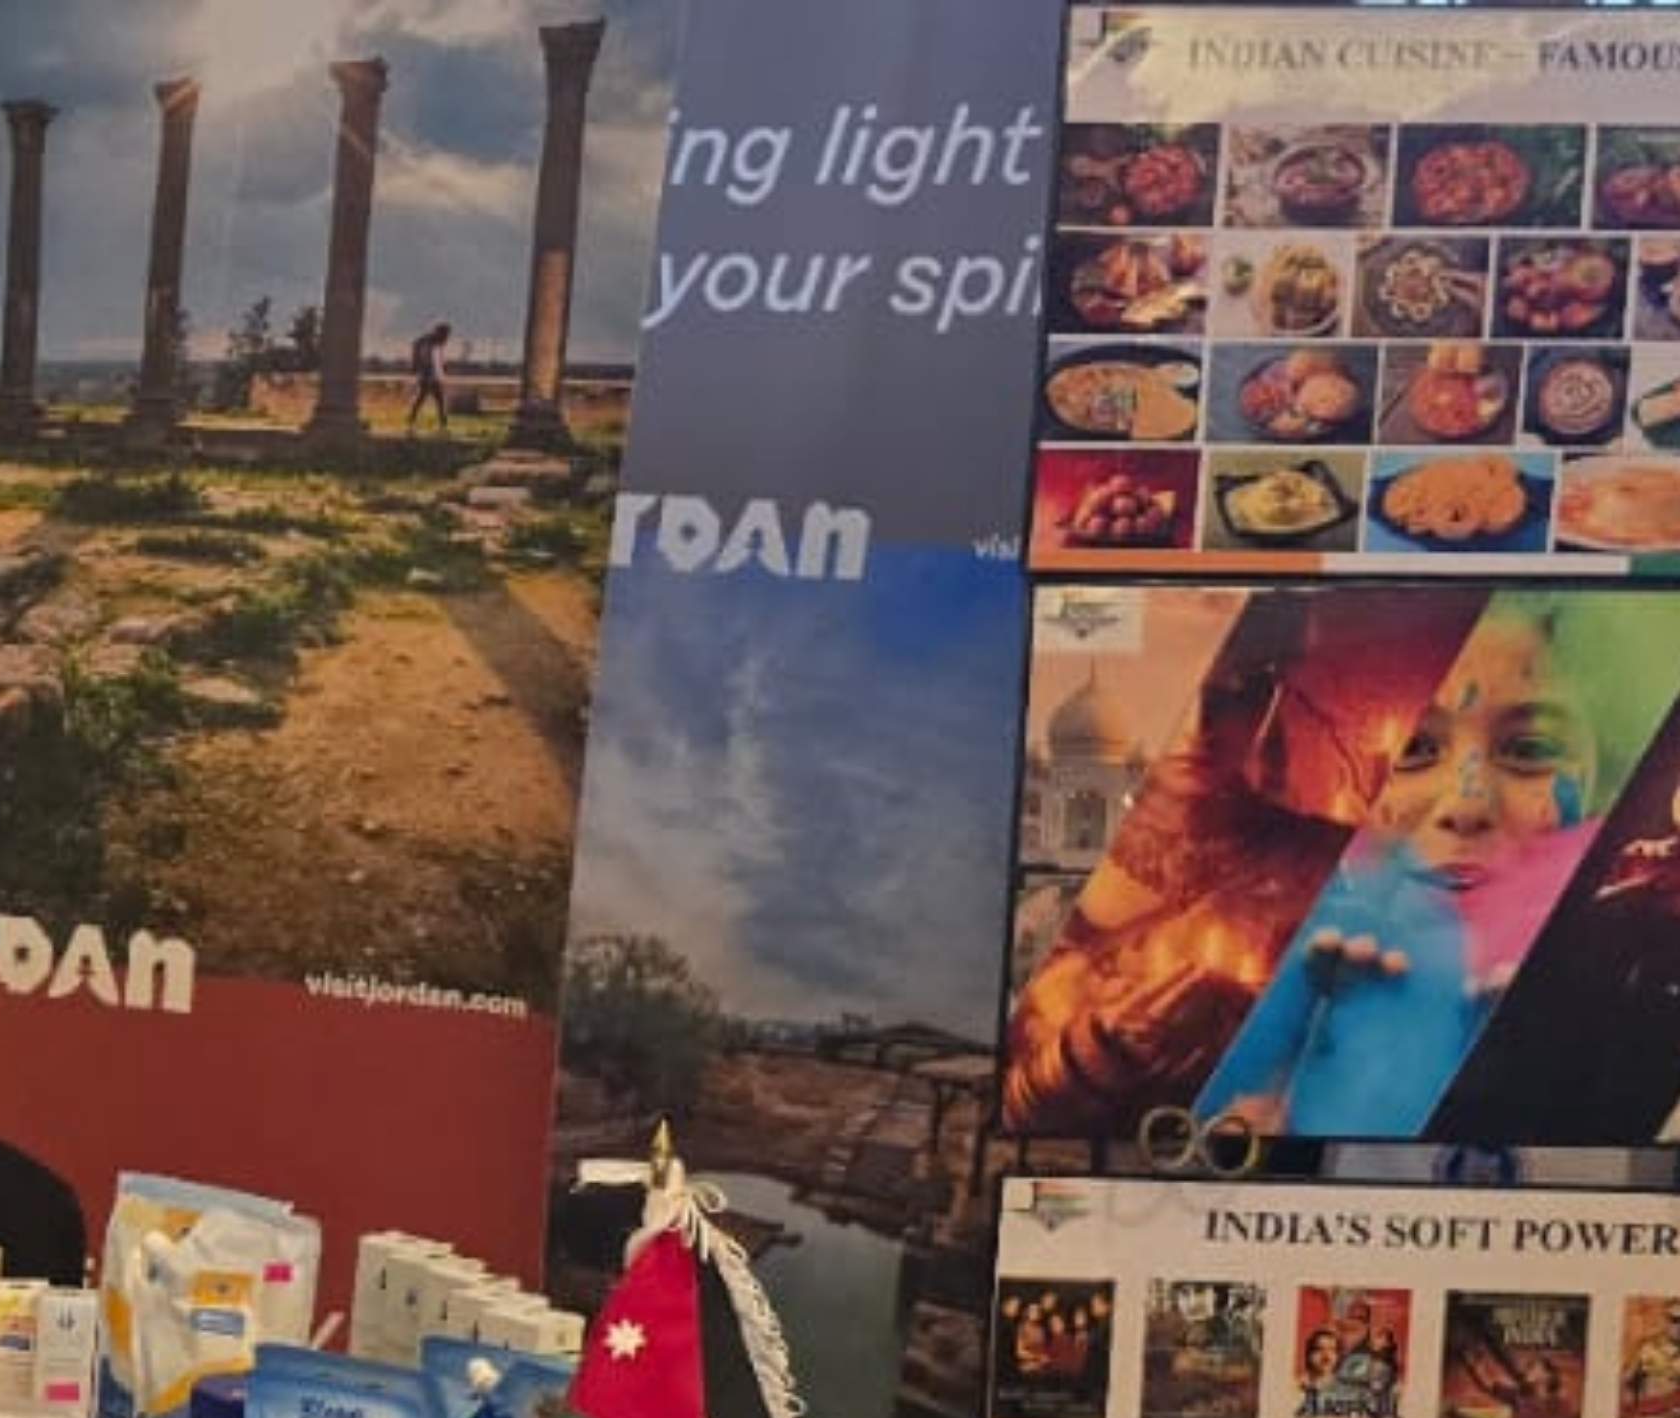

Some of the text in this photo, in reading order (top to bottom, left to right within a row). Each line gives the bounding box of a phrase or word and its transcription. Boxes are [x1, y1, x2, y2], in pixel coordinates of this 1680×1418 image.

[1188, 38, 1330, 71] INDIAN
[1336, 39, 1492, 72] CUISINE
[814, 104, 1042, 205] light
[642, 235, 1042, 333] your spi
[304, 972, 528, 1019] visitjordan.com
[1204, 1208, 1680, 1256] INDIA'S SOFT POWER
